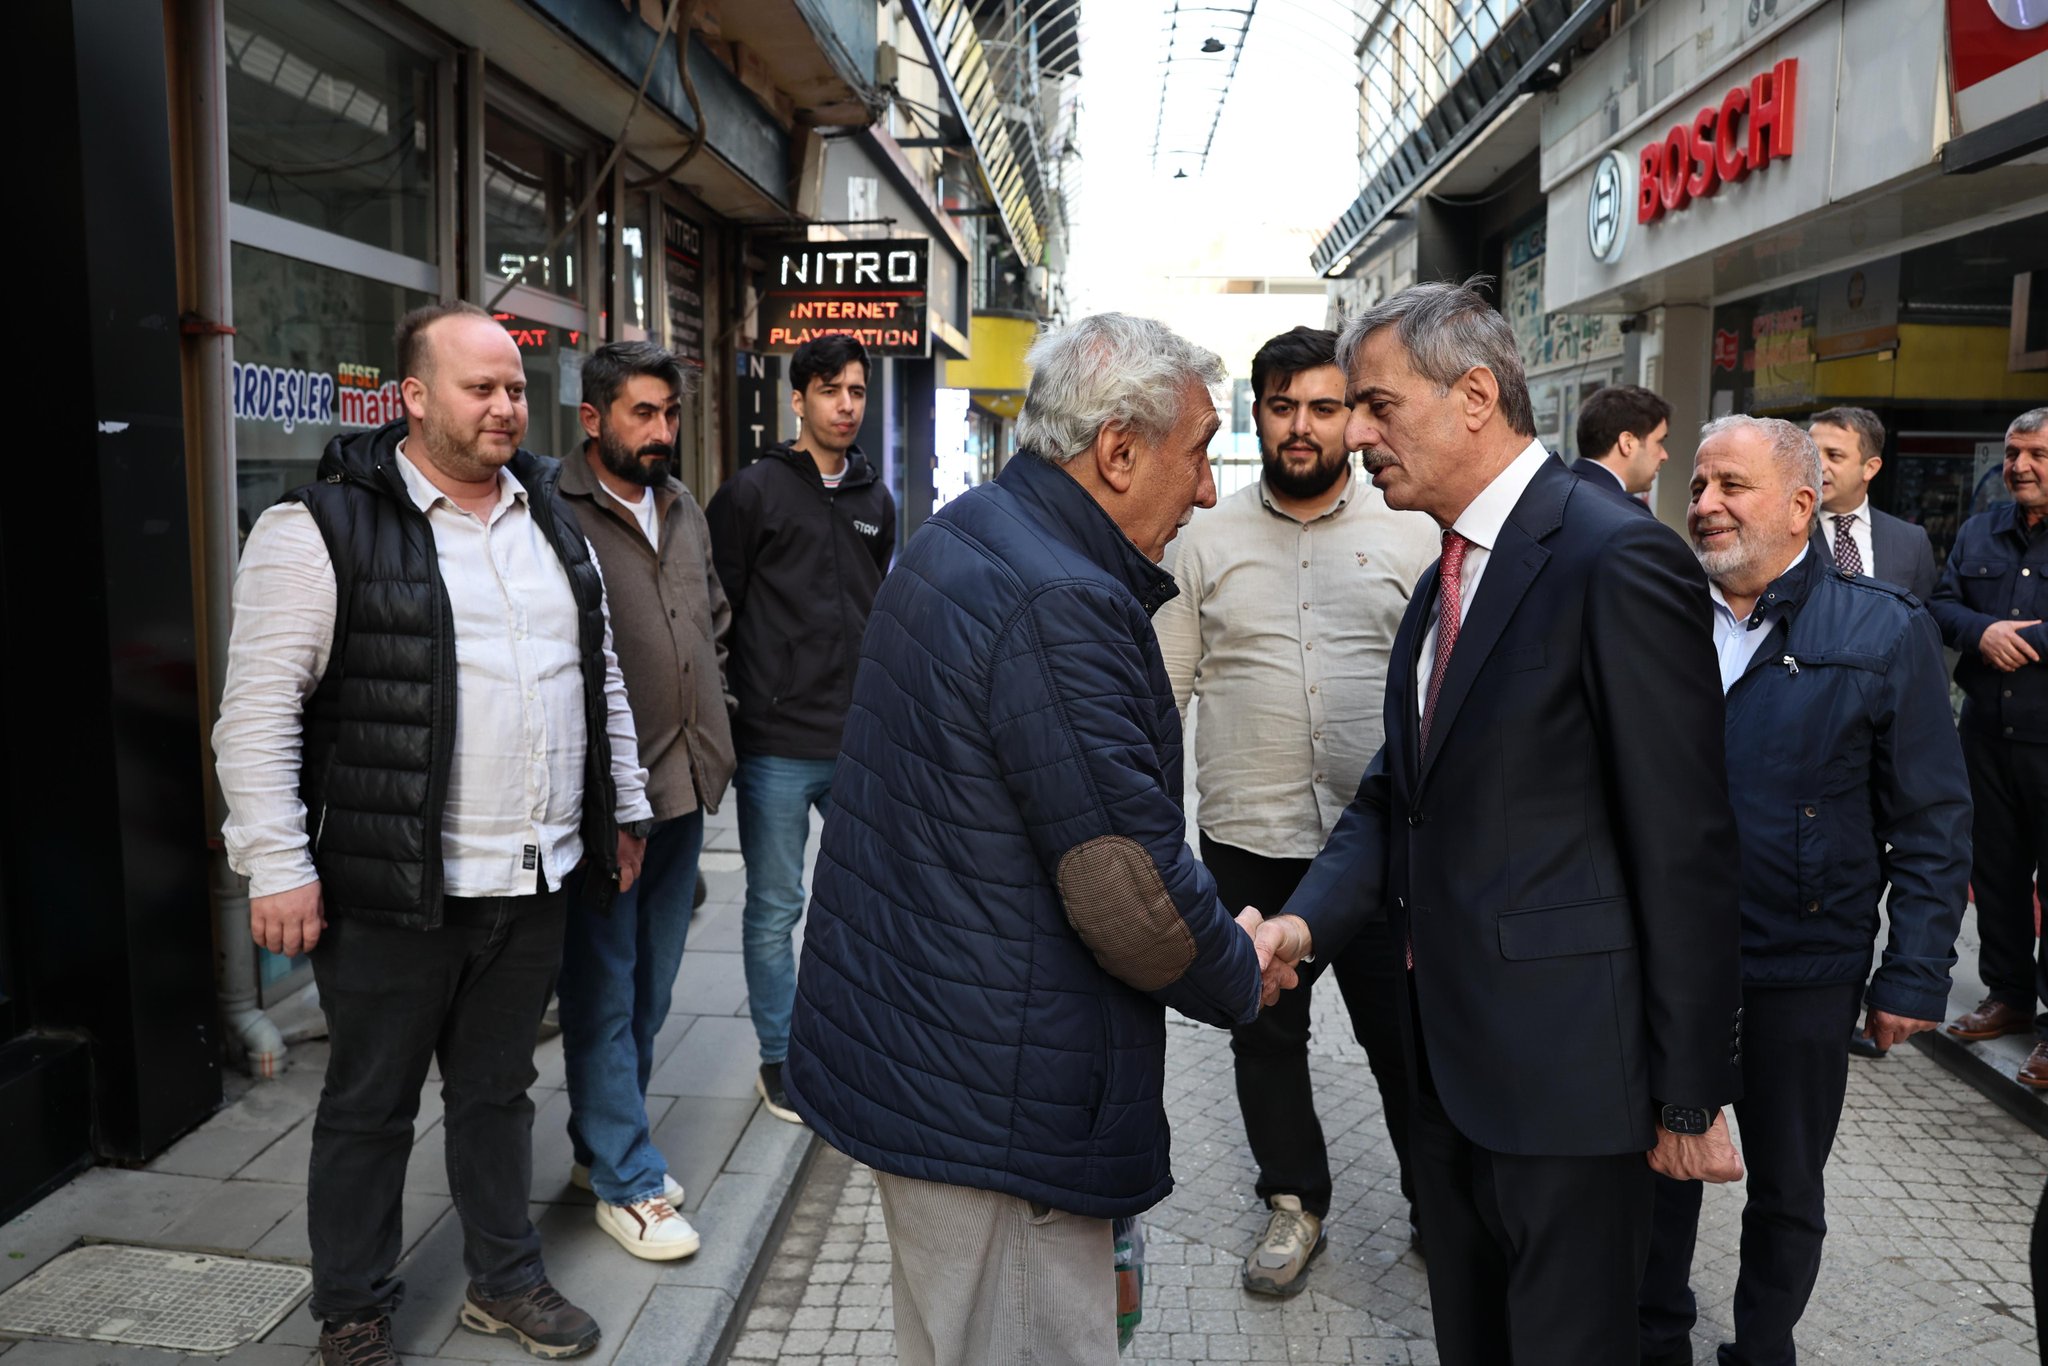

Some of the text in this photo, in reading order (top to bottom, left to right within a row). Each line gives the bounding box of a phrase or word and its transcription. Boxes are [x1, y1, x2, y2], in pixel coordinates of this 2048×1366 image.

[1637, 58, 1798, 225] BOSCH
[781, 250, 917, 285] NITRO
[789, 302, 899, 319] INTERNET
[338, 362, 380, 388] OFSET
[853, 520, 879, 536] STAY
